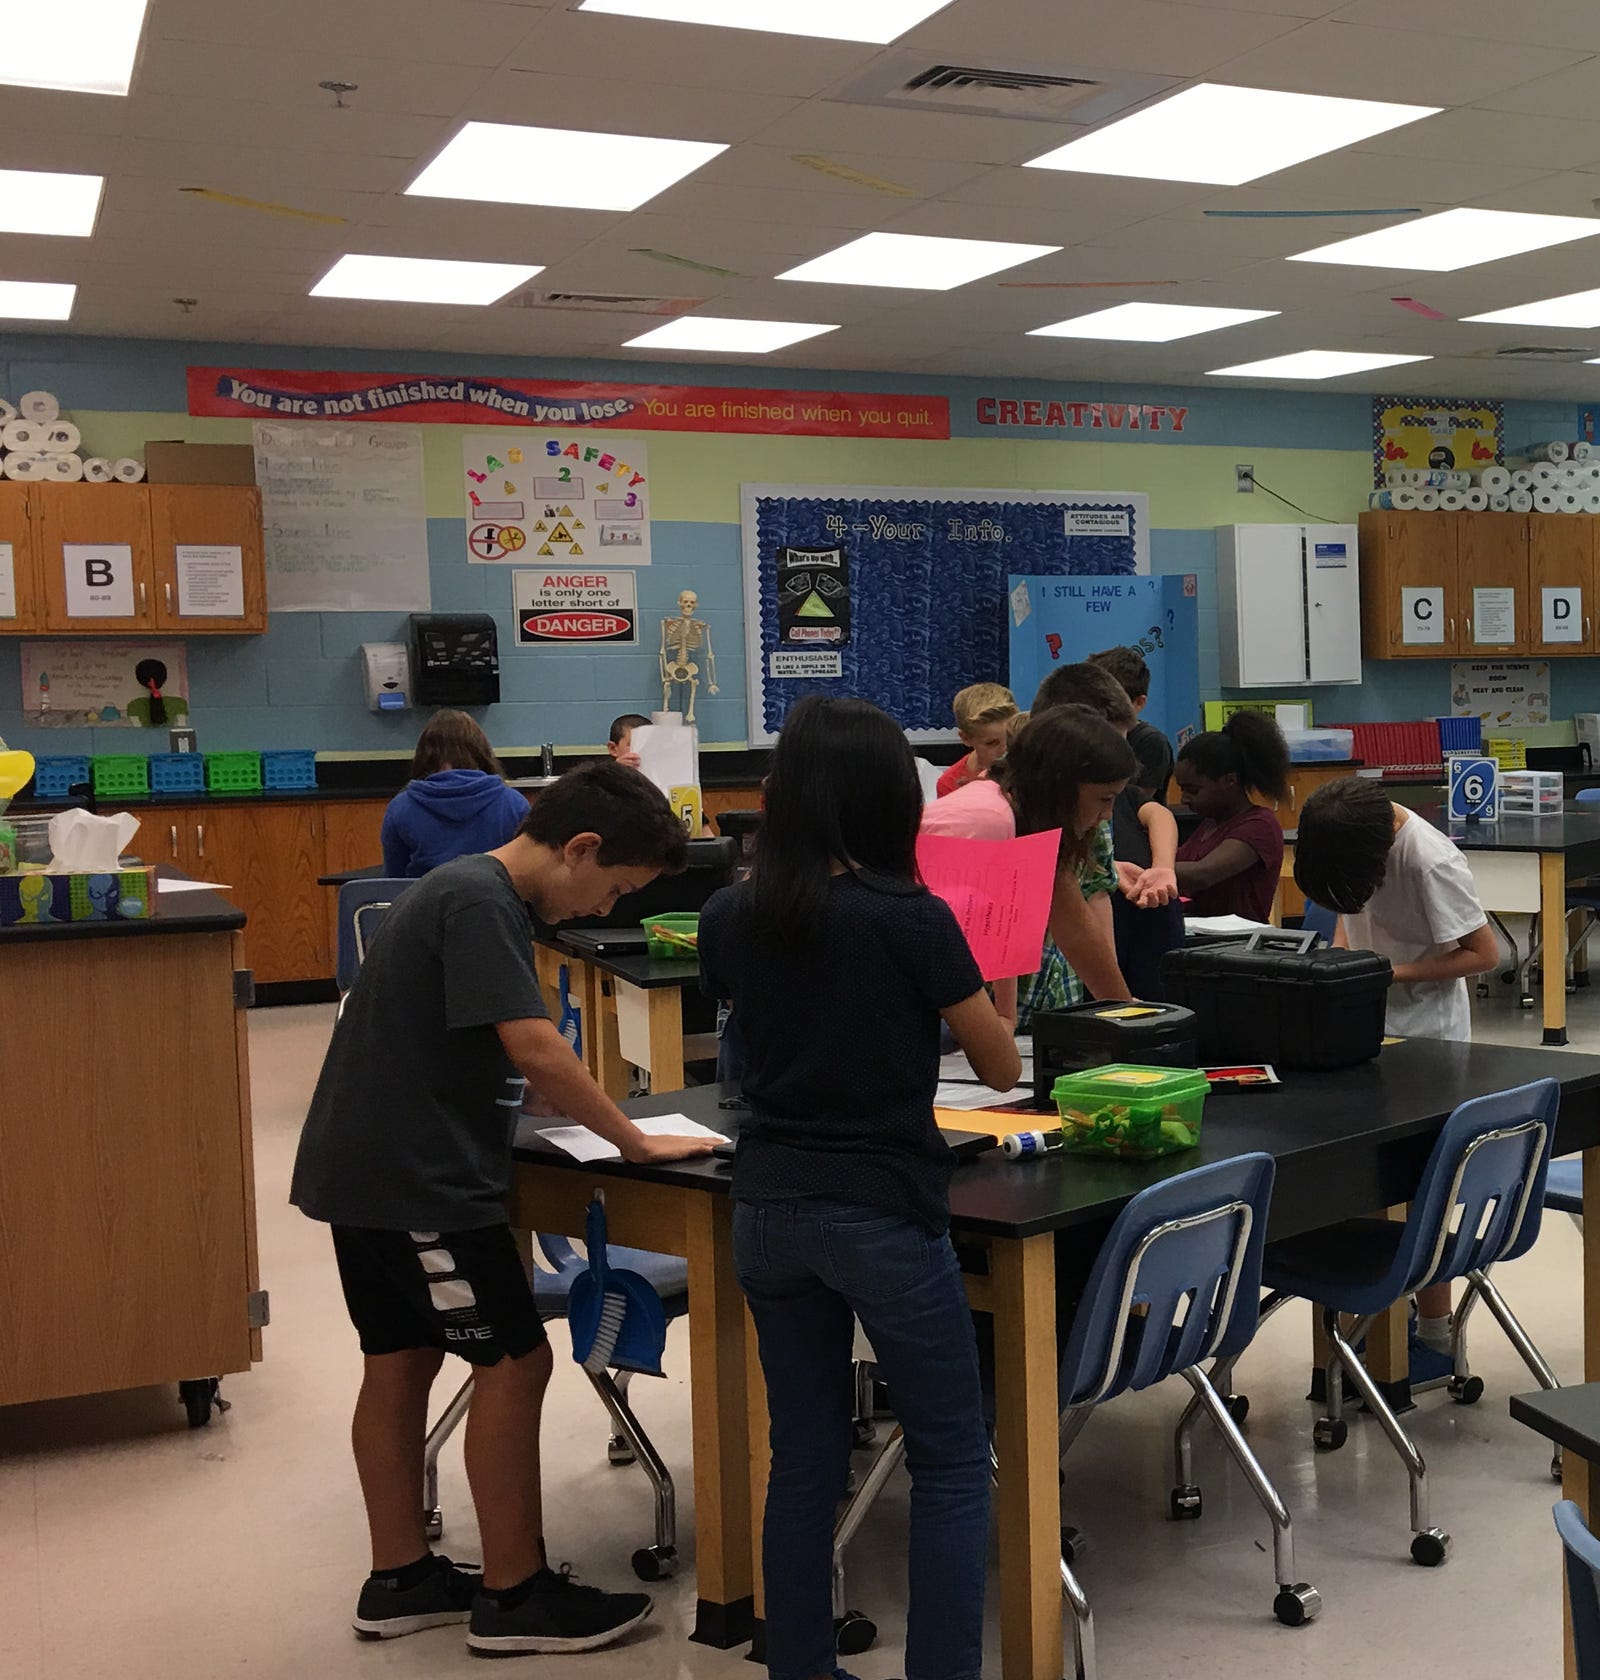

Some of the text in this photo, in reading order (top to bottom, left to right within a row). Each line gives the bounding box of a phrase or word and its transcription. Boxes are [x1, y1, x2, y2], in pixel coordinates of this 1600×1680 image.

[230, 378, 934, 428] You are not finished when you lose. You are finished when you quit.
[976, 396, 1188, 433] CREATIVITY
[467, 447, 524, 484] LAB
[546, 440, 646, 488] SAFETY
[559, 467, 571, 483] 2
[624, 492, 638, 508] 3
[947, 518, 1013, 544] Info.
[85, 558, 114, 587] B
[543, 575, 608, 588] ANGER
[539, 588, 611, 599] is only one
[1053, 585, 1086, 599] STILL
[1091, 585, 1123, 598] HAVE
[1127, 584, 1137, 597] A
[531, 598, 620, 607] letter short of
[1086, 600, 1112, 613] FEW
[1413, 597, 1433, 621] C
[1553, 598, 1570, 620] D
[536, 618, 618, 633] DANGER
[775, 654, 838, 662] ENTHUSIASM
[1506, 663, 1530, 671] SCIENCE
[1454, 761, 1462, 771] 6
[1464, 775, 1483, 800] 6
